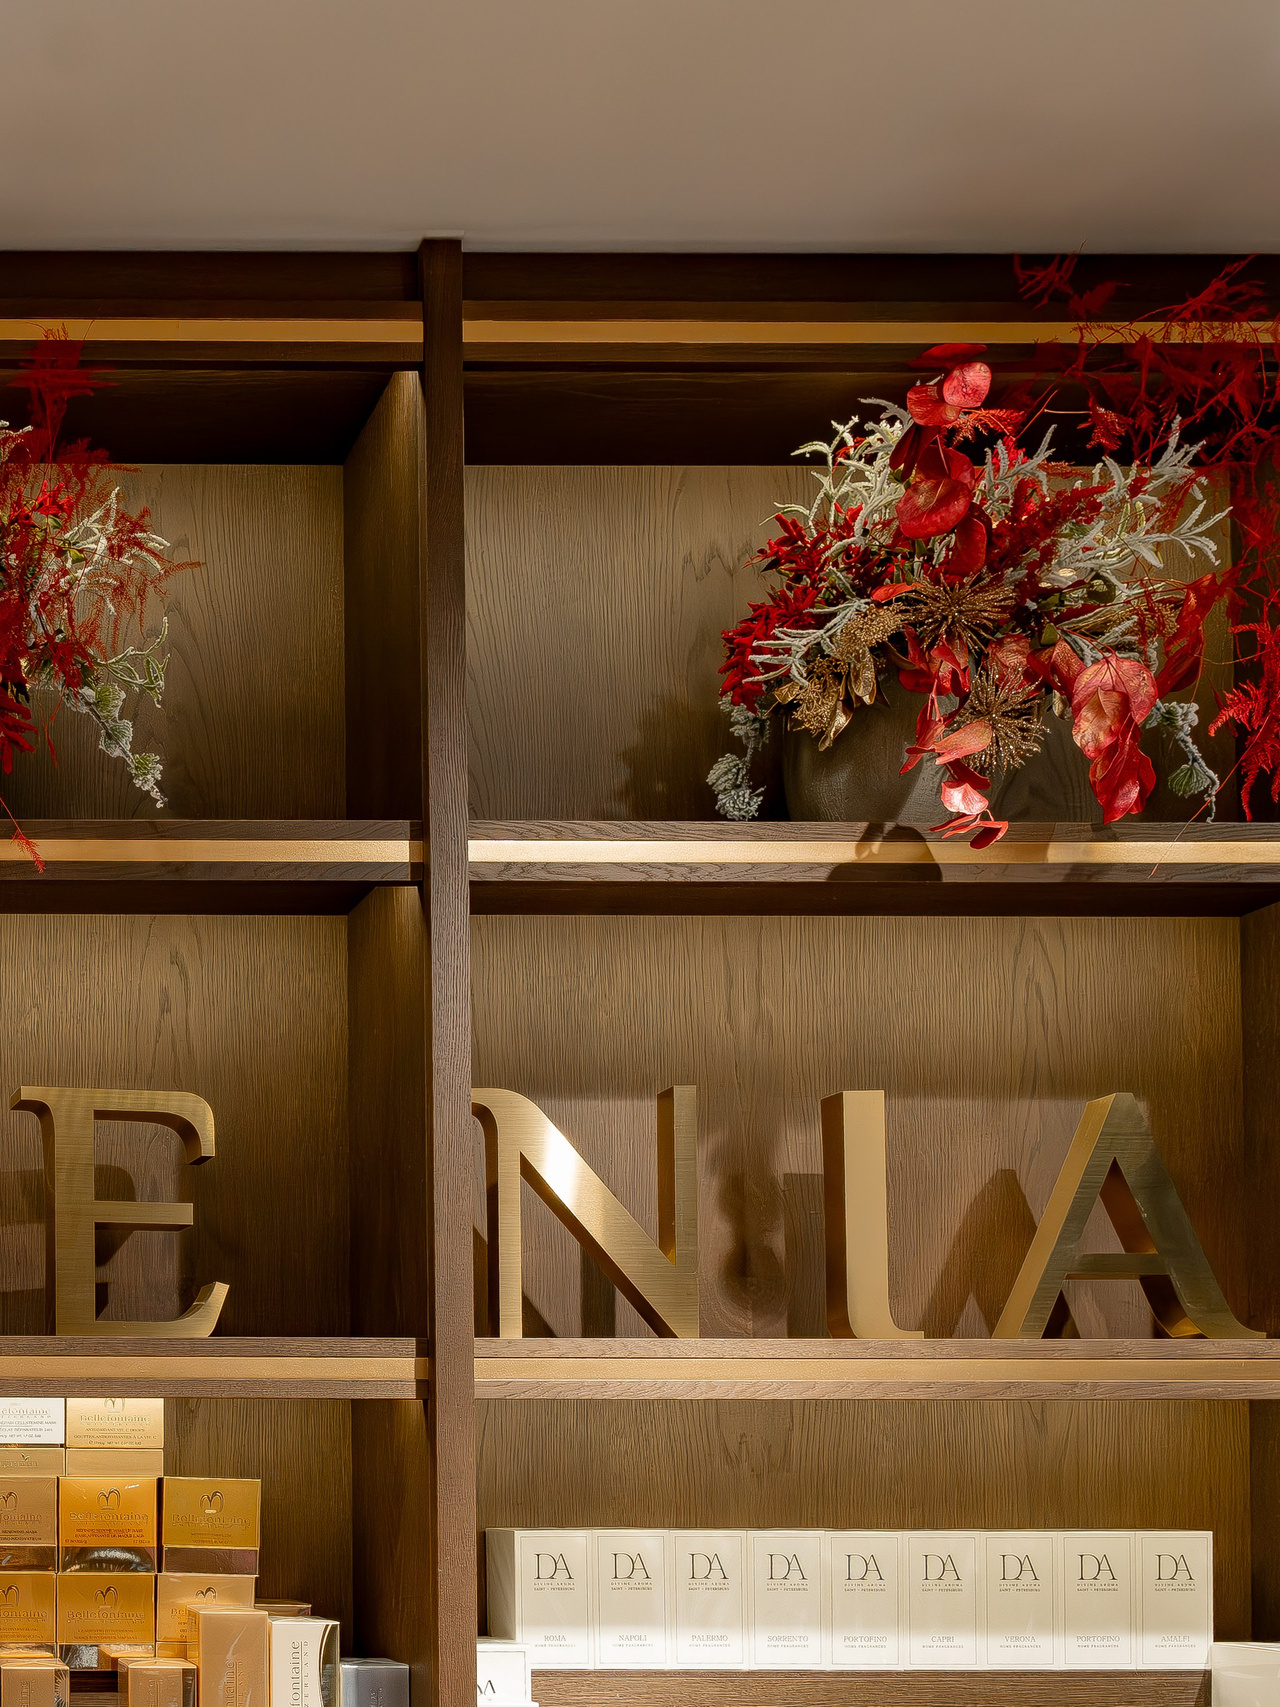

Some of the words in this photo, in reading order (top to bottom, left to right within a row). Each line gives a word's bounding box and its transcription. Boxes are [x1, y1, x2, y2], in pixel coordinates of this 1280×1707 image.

[80, 1414, 150, 1422] Bellefontaine
[533, 1553, 575, 1580] DA
[610, 1553, 652, 1580] DA
[688, 1553, 730, 1580] DA
[767, 1553, 808, 1580] DA
[844, 1554, 885, 1581] DA
[921, 1554, 962, 1581] DA
[999, 1554, 1040, 1581] DA
[1077, 1554, 1118, 1581] DA
[1155, 1554, 1195, 1581] DA
[767, 1635, 809, 1643] SORRENTO
